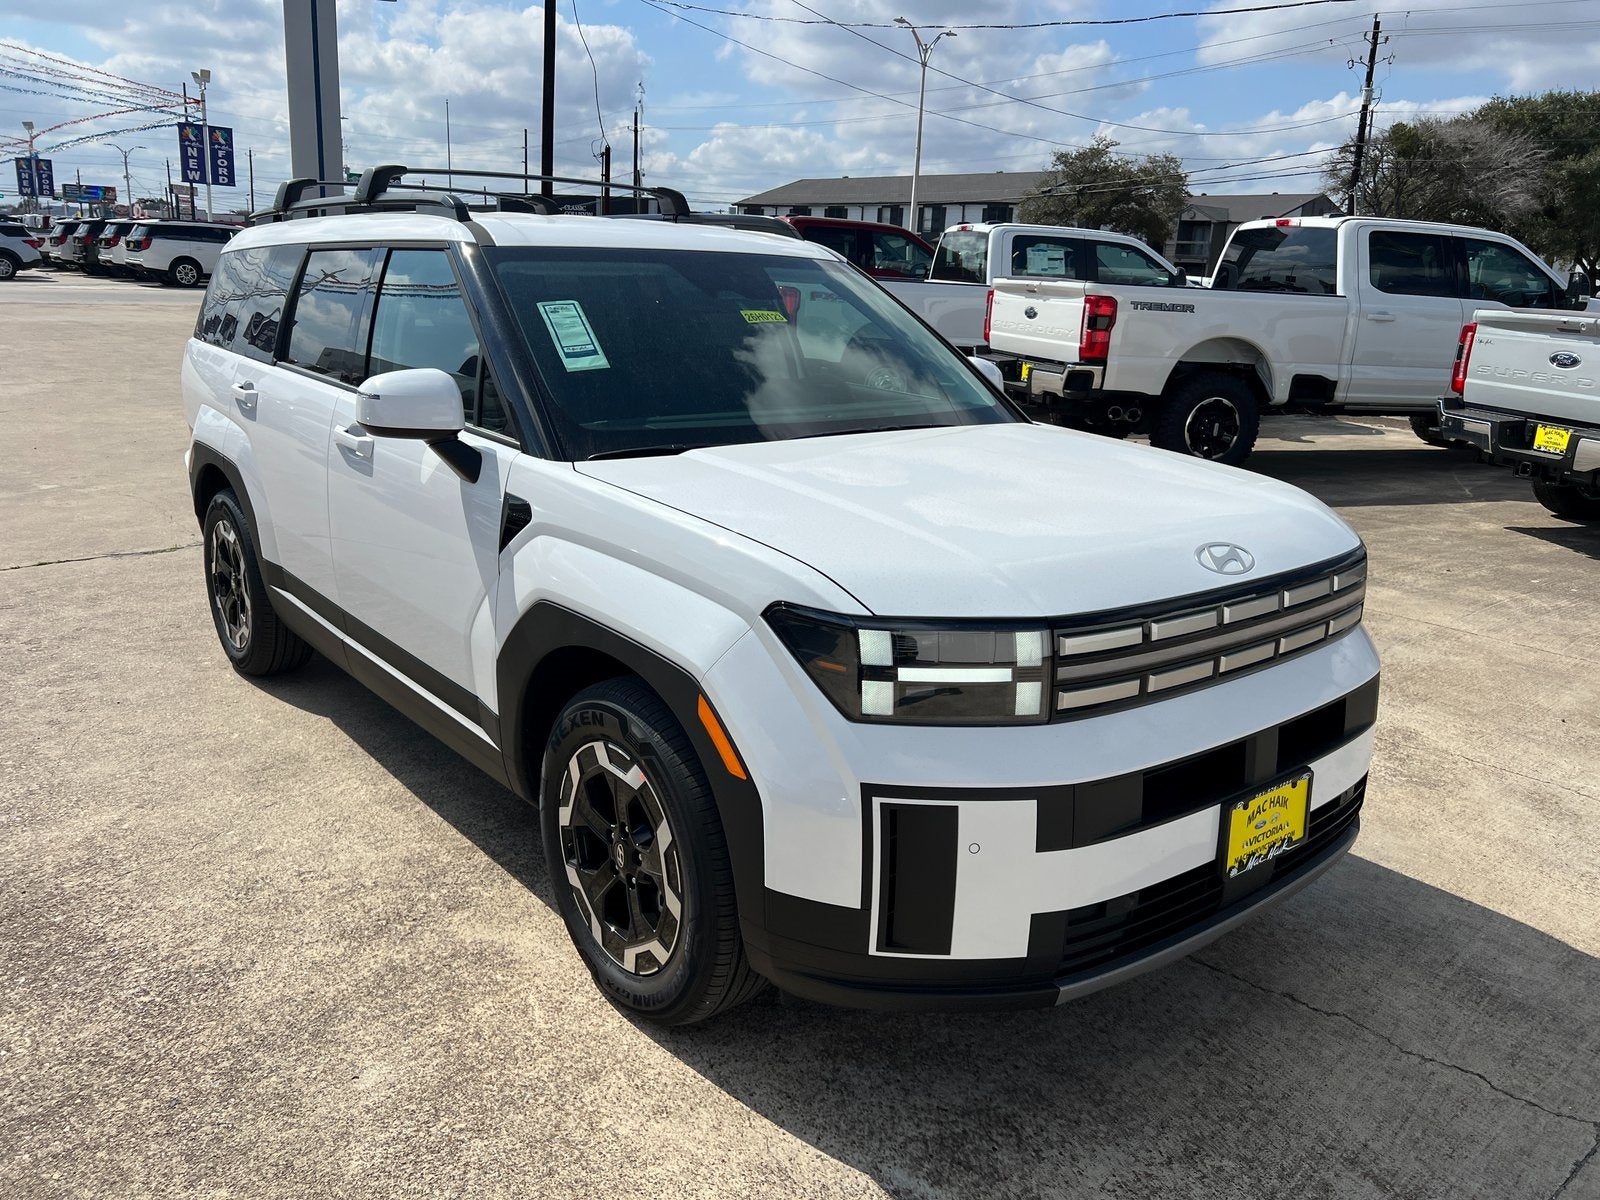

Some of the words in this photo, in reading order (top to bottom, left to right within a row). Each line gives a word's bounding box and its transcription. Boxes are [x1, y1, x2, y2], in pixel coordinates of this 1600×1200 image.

[187, 146, 200, 181] NEW
[216, 150, 229, 184] FORD
[21, 172, 32, 194] NEW
[41, 173, 50, 195] FORD
[1130, 300, 1195, 314] TREMOR
[993, 319, 1033, 332] SUPER
[1036, 325, 1074, 337] DUTY
[1477, 364, 1568, 386] SUPER
[1246, 799, 1268, 828] MAC
